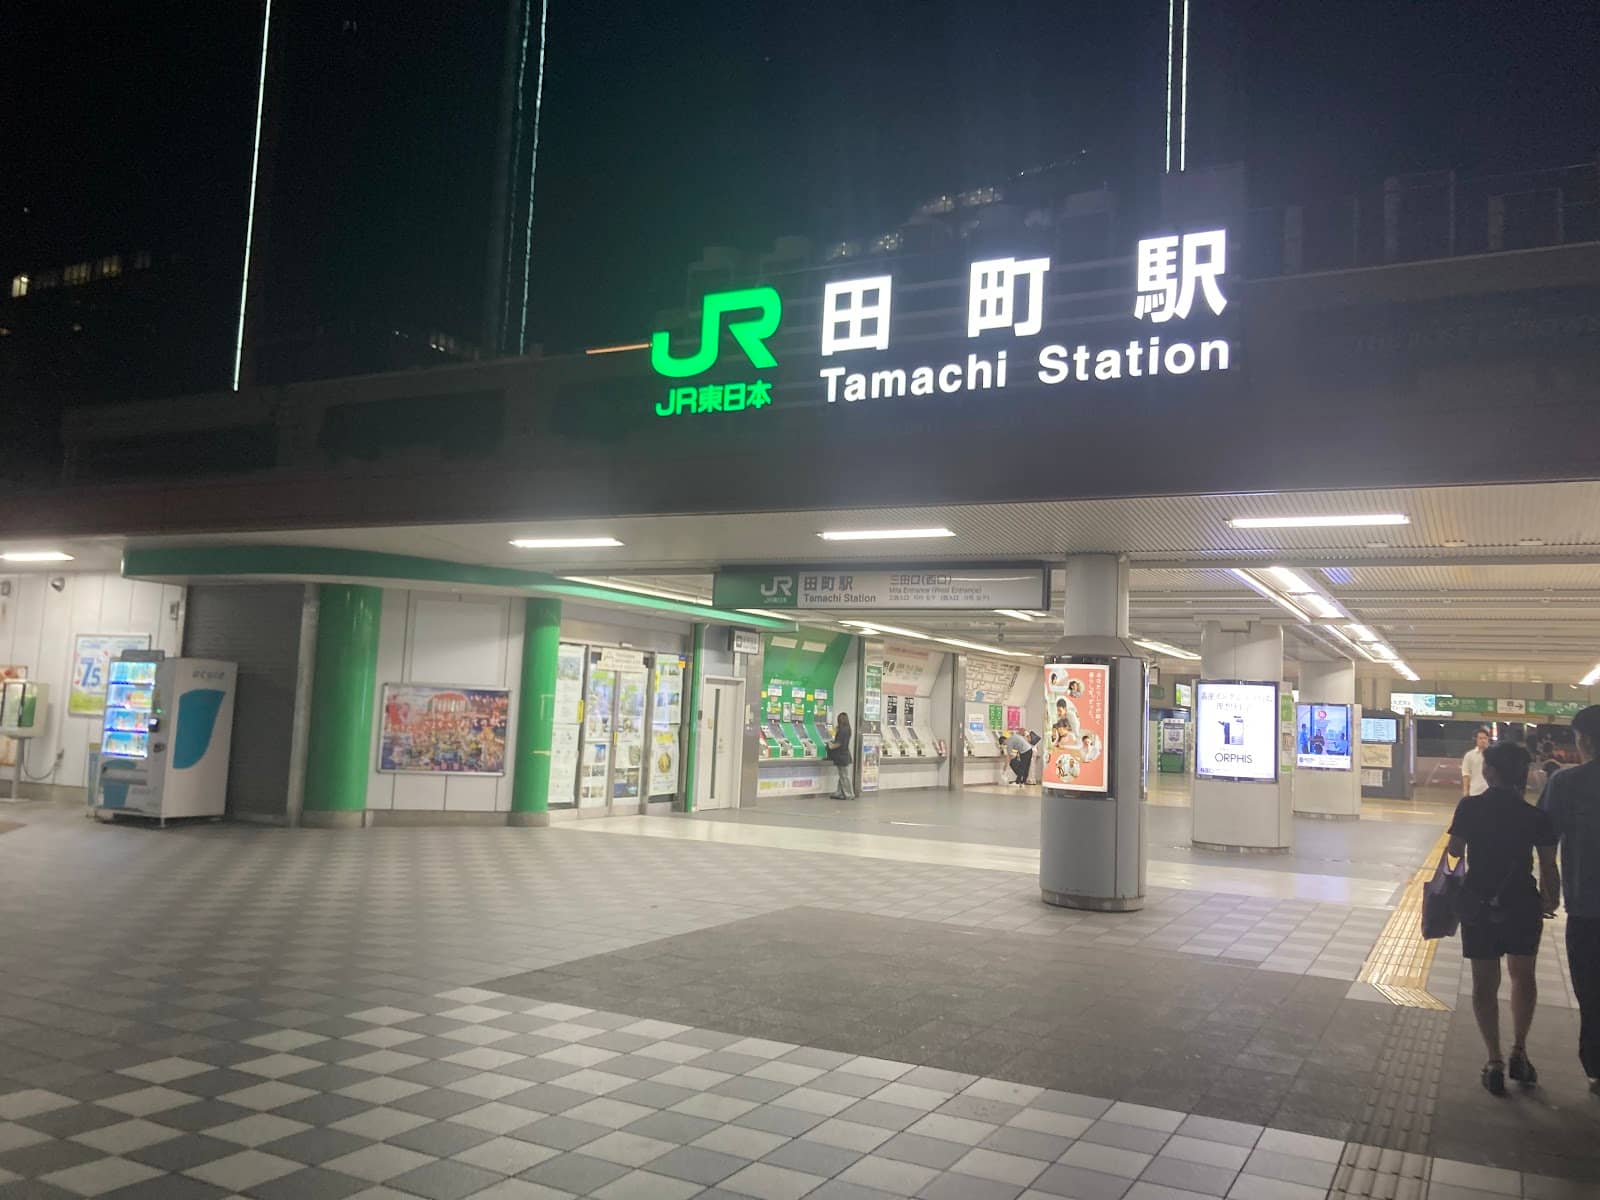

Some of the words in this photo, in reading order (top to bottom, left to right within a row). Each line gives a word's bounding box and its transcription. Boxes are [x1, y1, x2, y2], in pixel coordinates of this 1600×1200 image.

[822, 230, 1227, 355] 田町駅
[650, 286, 782, 379] JR
[820, 352, 1008, 404] Tamachi
[1038, 337, 1230, 386] Station
[655, 379, 773, 417] JR東日本
[760, 576, 793, 596] JR
[803, 575, 854, 592] 田町駅
[803, 593, 841, 603] Tamachi
[844, 593, 876, 603] Station
[1214, 752, 1253, 764] ORPHIS
